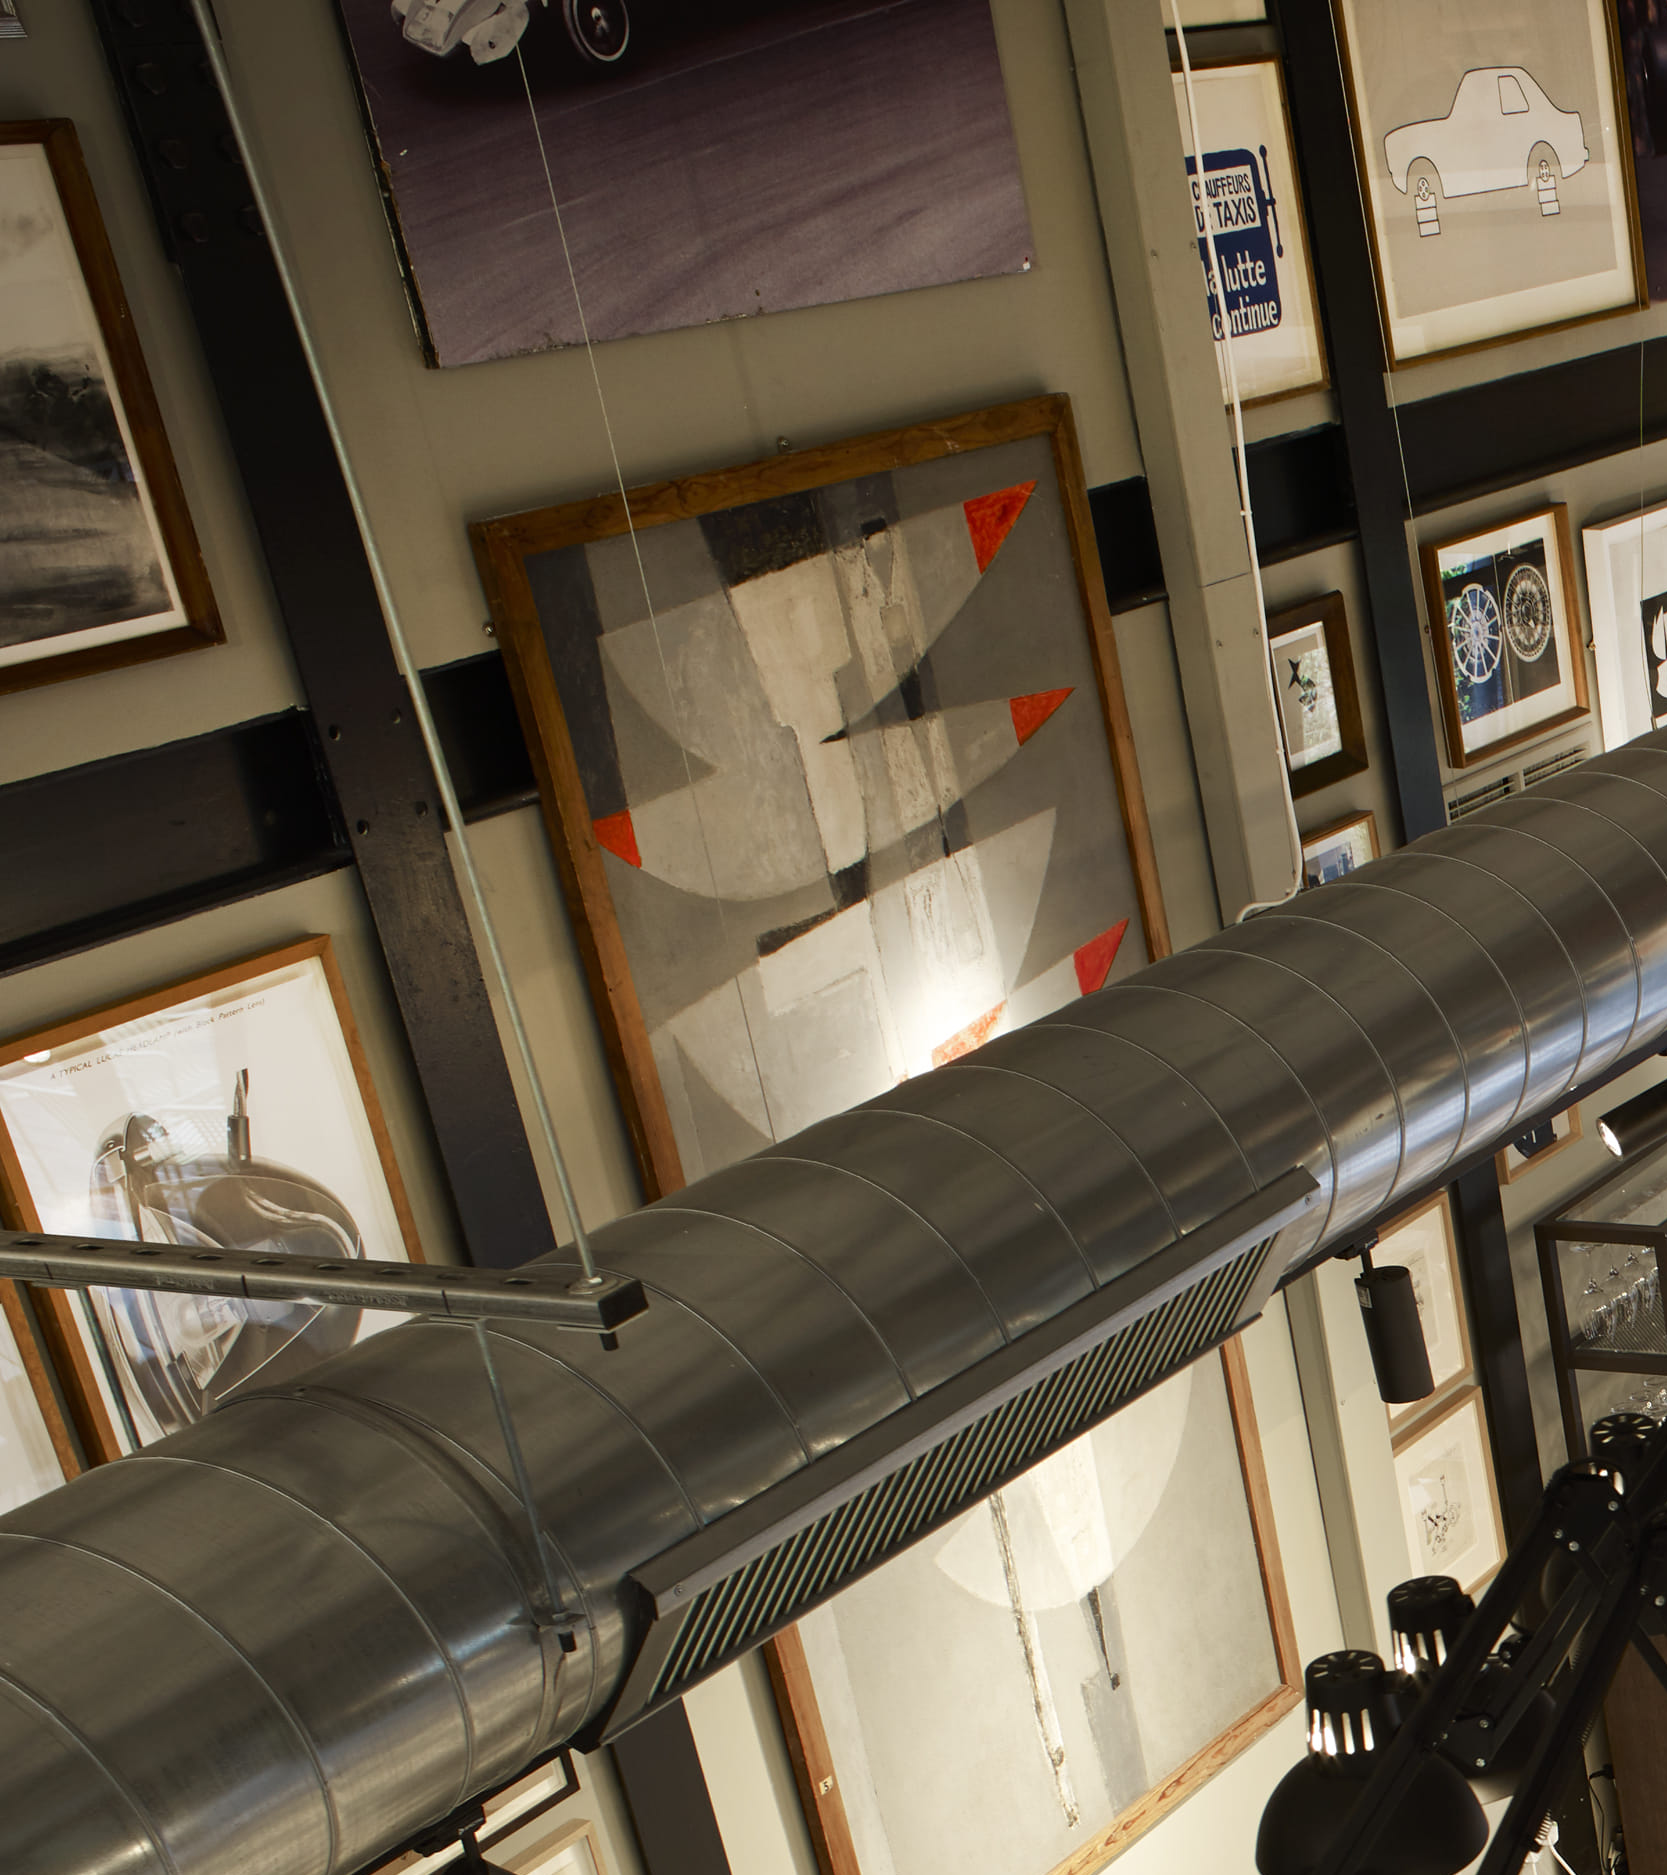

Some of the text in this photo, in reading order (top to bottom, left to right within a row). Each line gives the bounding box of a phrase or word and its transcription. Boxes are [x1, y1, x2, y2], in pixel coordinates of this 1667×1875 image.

[1191, 173, 1251, 201] CAUFFEURS
[1213, 196, 1256, 229] TAXIS
[1221, 250, 1266, 293] lutte
[59, 1061, 92, 1078] TYPICAL
